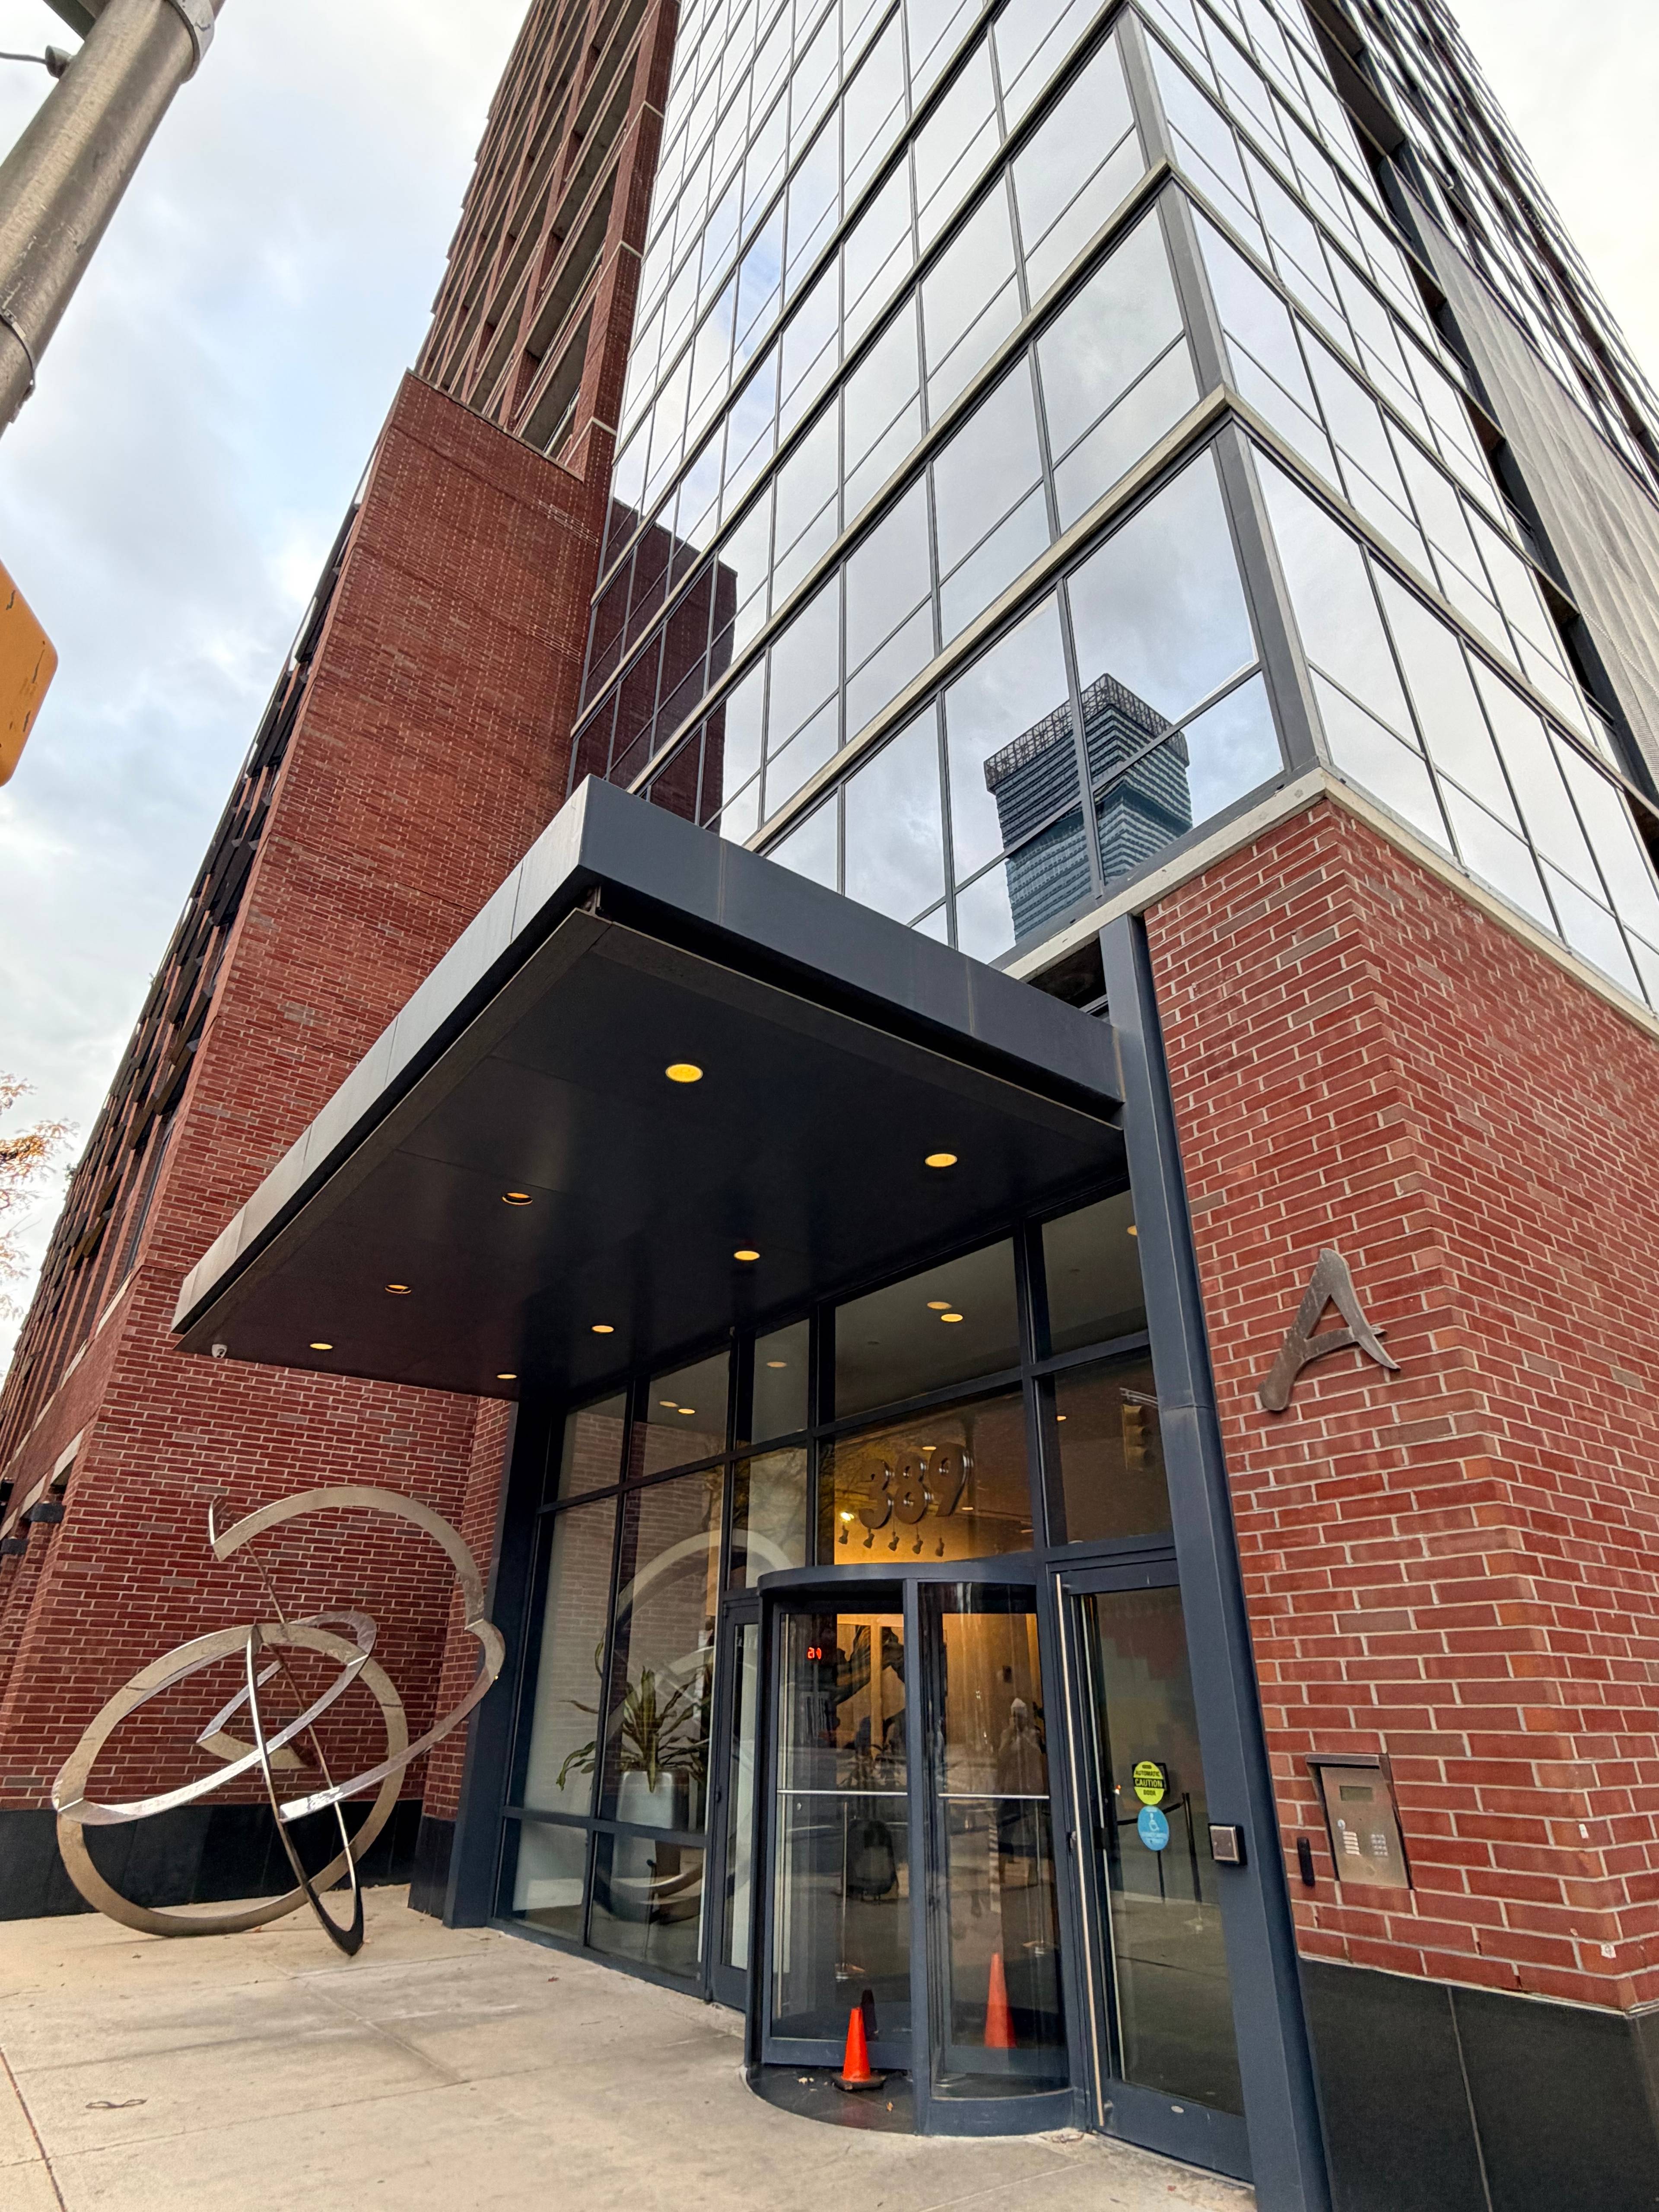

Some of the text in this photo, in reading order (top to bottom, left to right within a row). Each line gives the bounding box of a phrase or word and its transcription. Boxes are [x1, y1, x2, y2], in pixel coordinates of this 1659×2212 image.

[1258, 1248, 1401, 1411] A
[858, 1442, 974, 1529] 389
[1135, 1778, 1163, 1788] CAUTION
